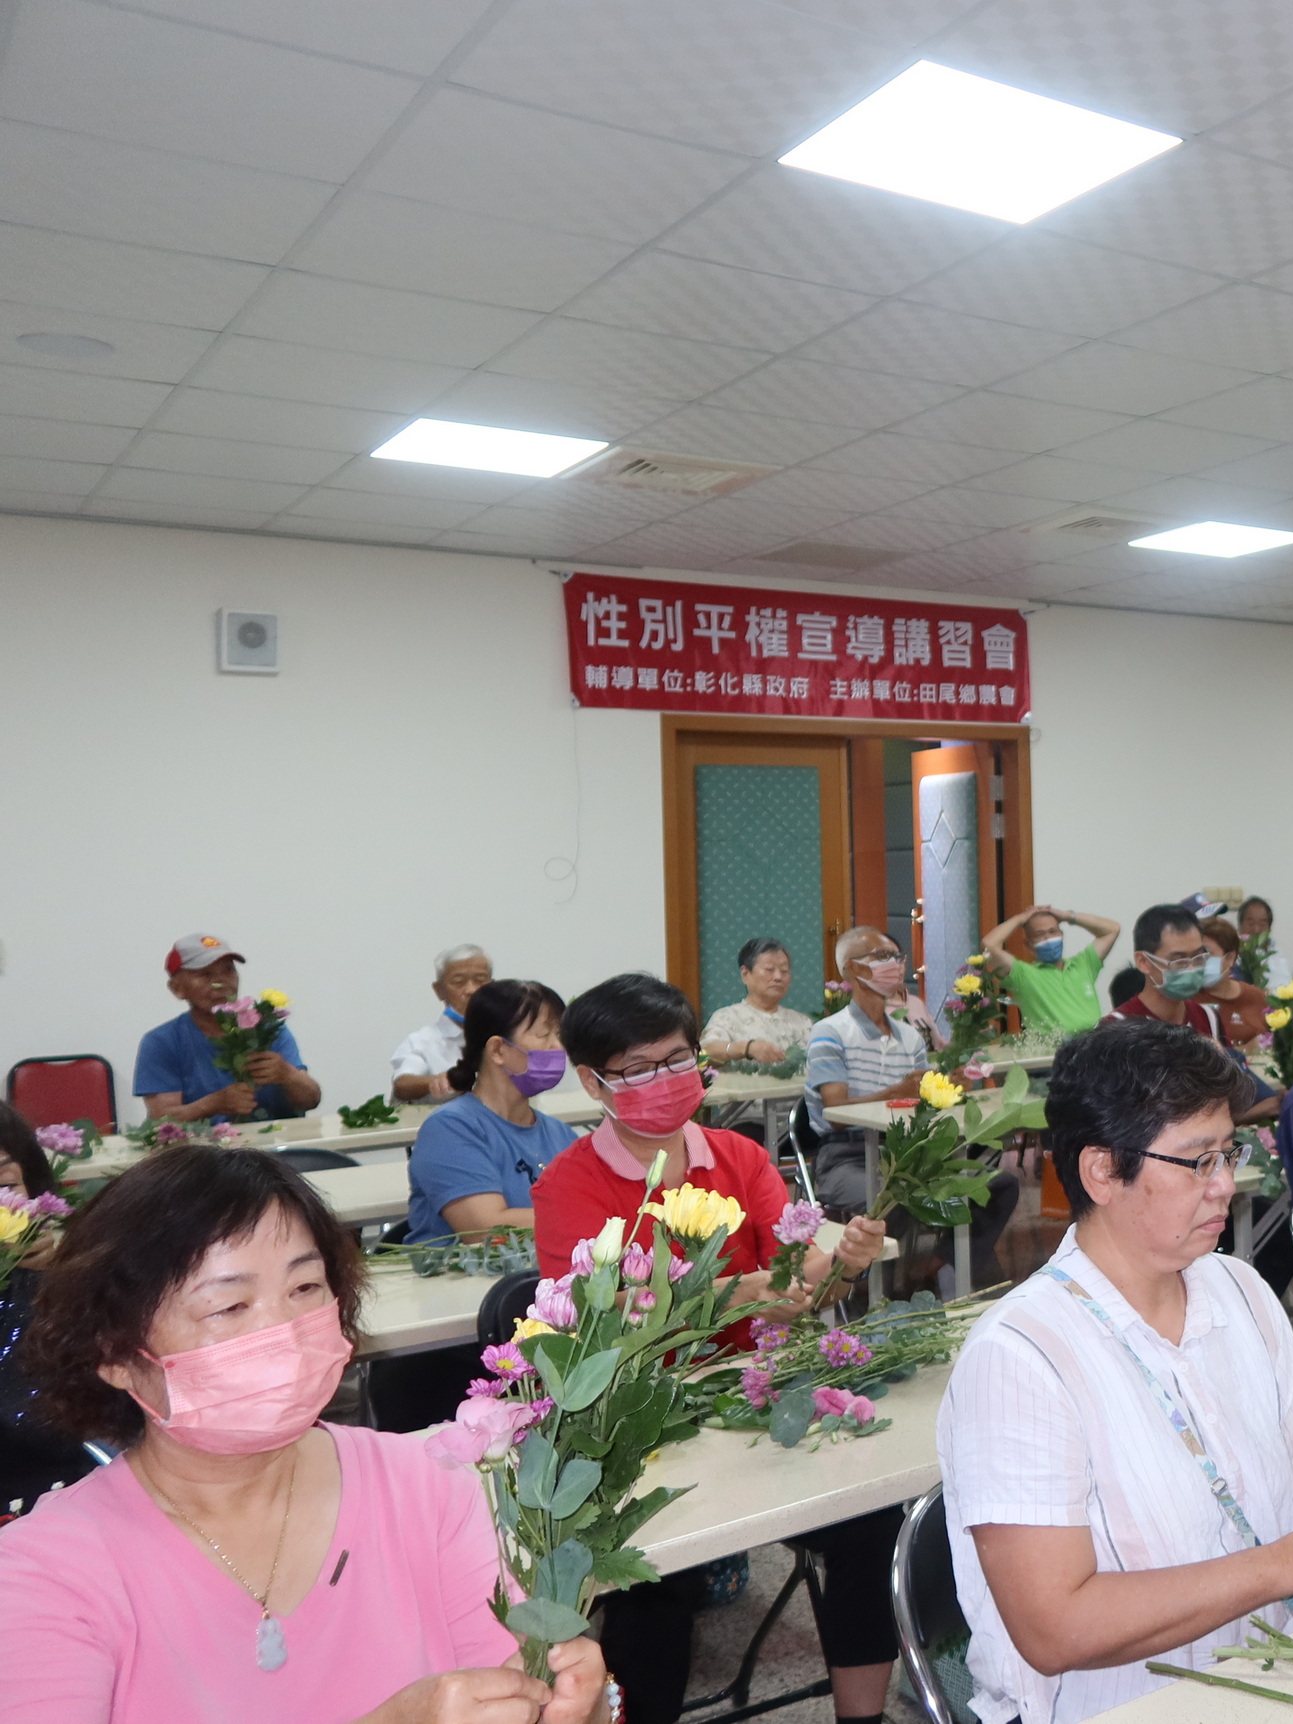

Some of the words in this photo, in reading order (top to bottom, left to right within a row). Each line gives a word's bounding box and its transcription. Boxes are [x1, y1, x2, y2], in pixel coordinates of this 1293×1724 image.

[580, 592, 1016, 671] 性別平權宣導講習會
